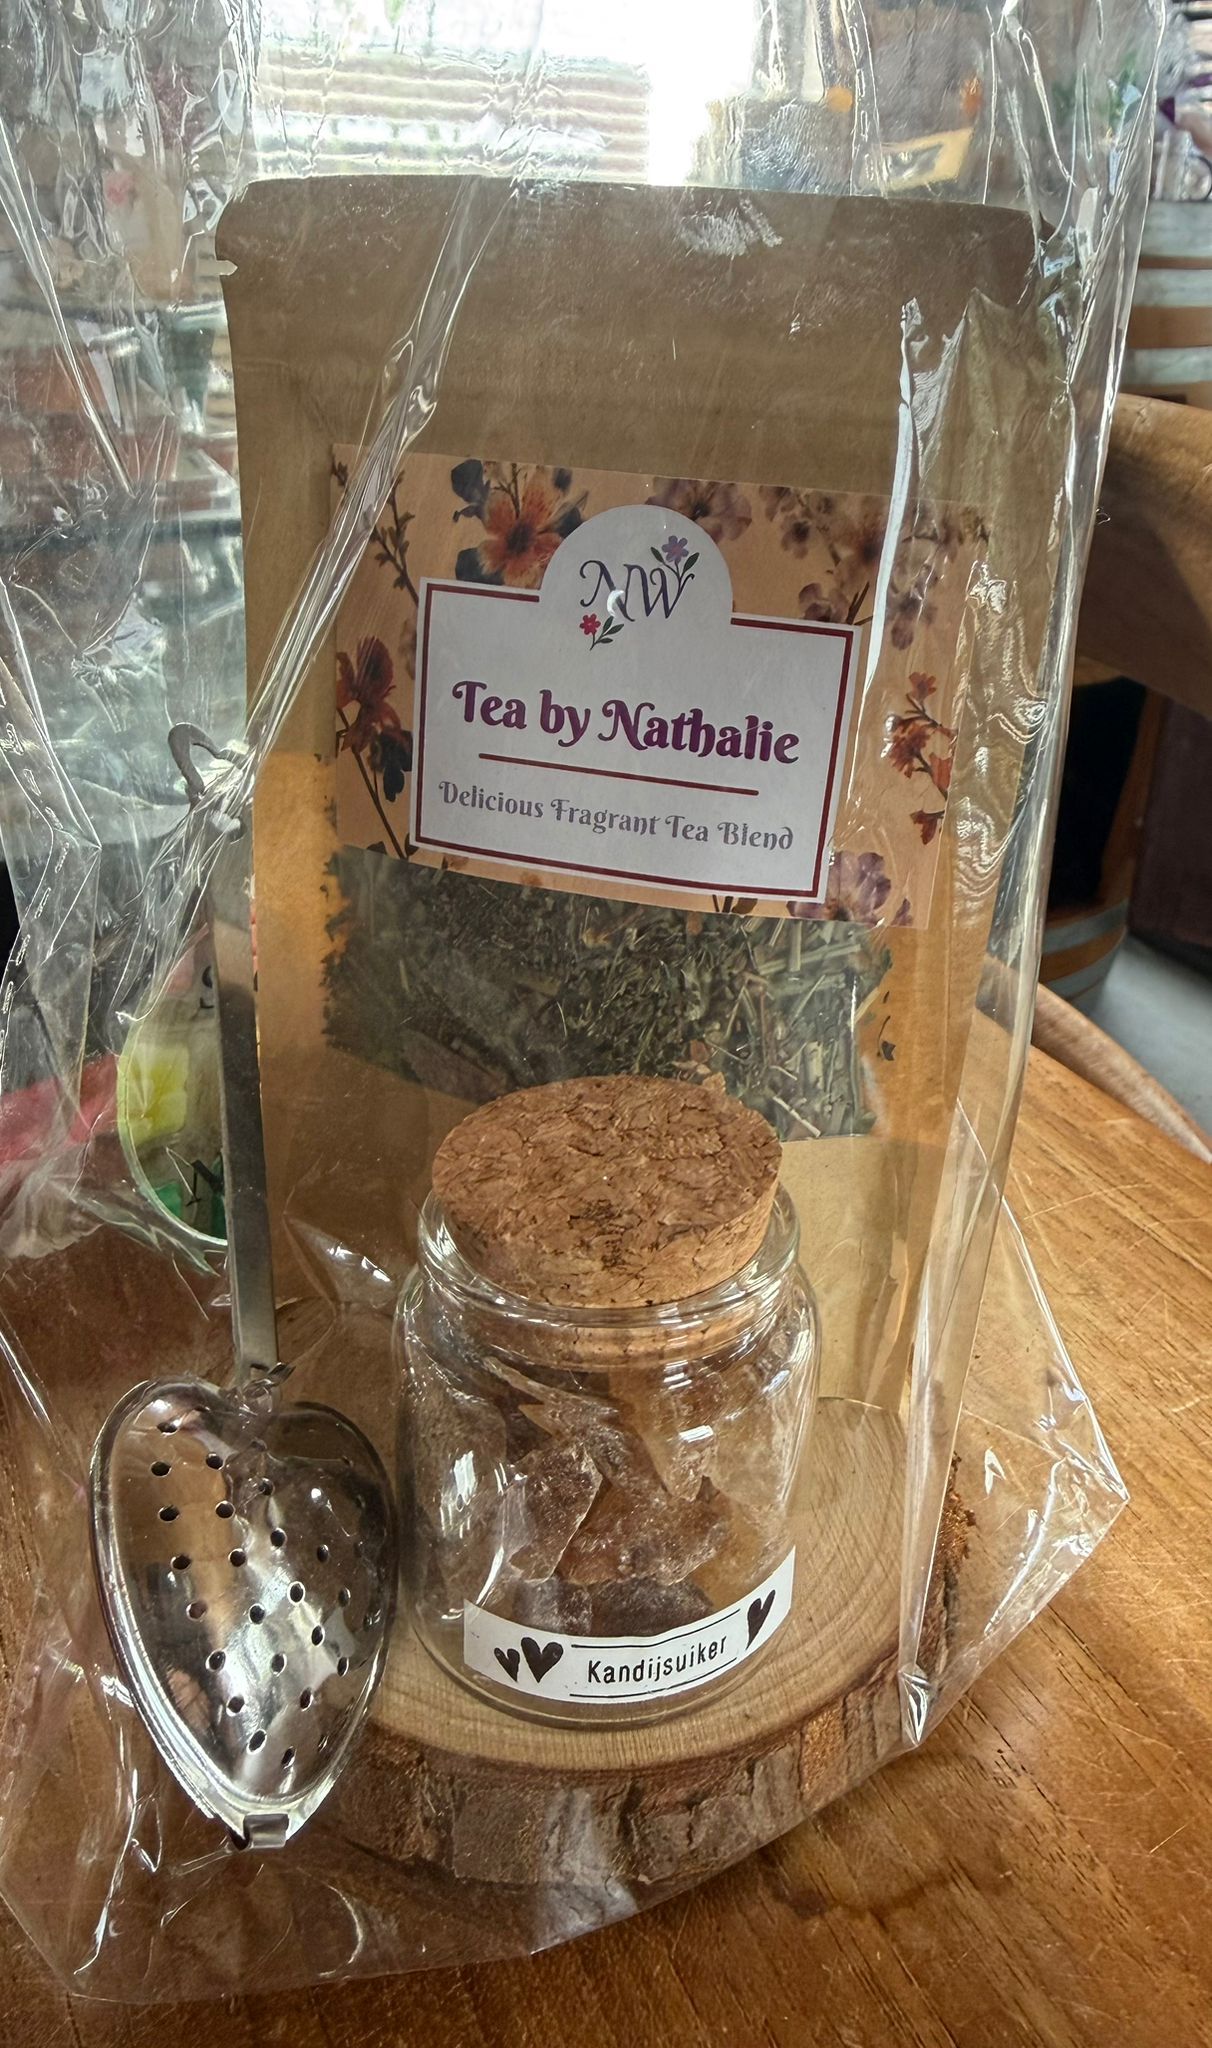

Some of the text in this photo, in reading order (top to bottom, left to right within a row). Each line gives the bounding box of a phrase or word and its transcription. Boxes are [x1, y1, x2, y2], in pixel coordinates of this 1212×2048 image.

[452, 680, 799, 764] Tea by Nathalie
[438, 780, 794, 851] Delicious Fragrant Tea Blend
[587, 1635, 727, 1684] Kandijsuiker
